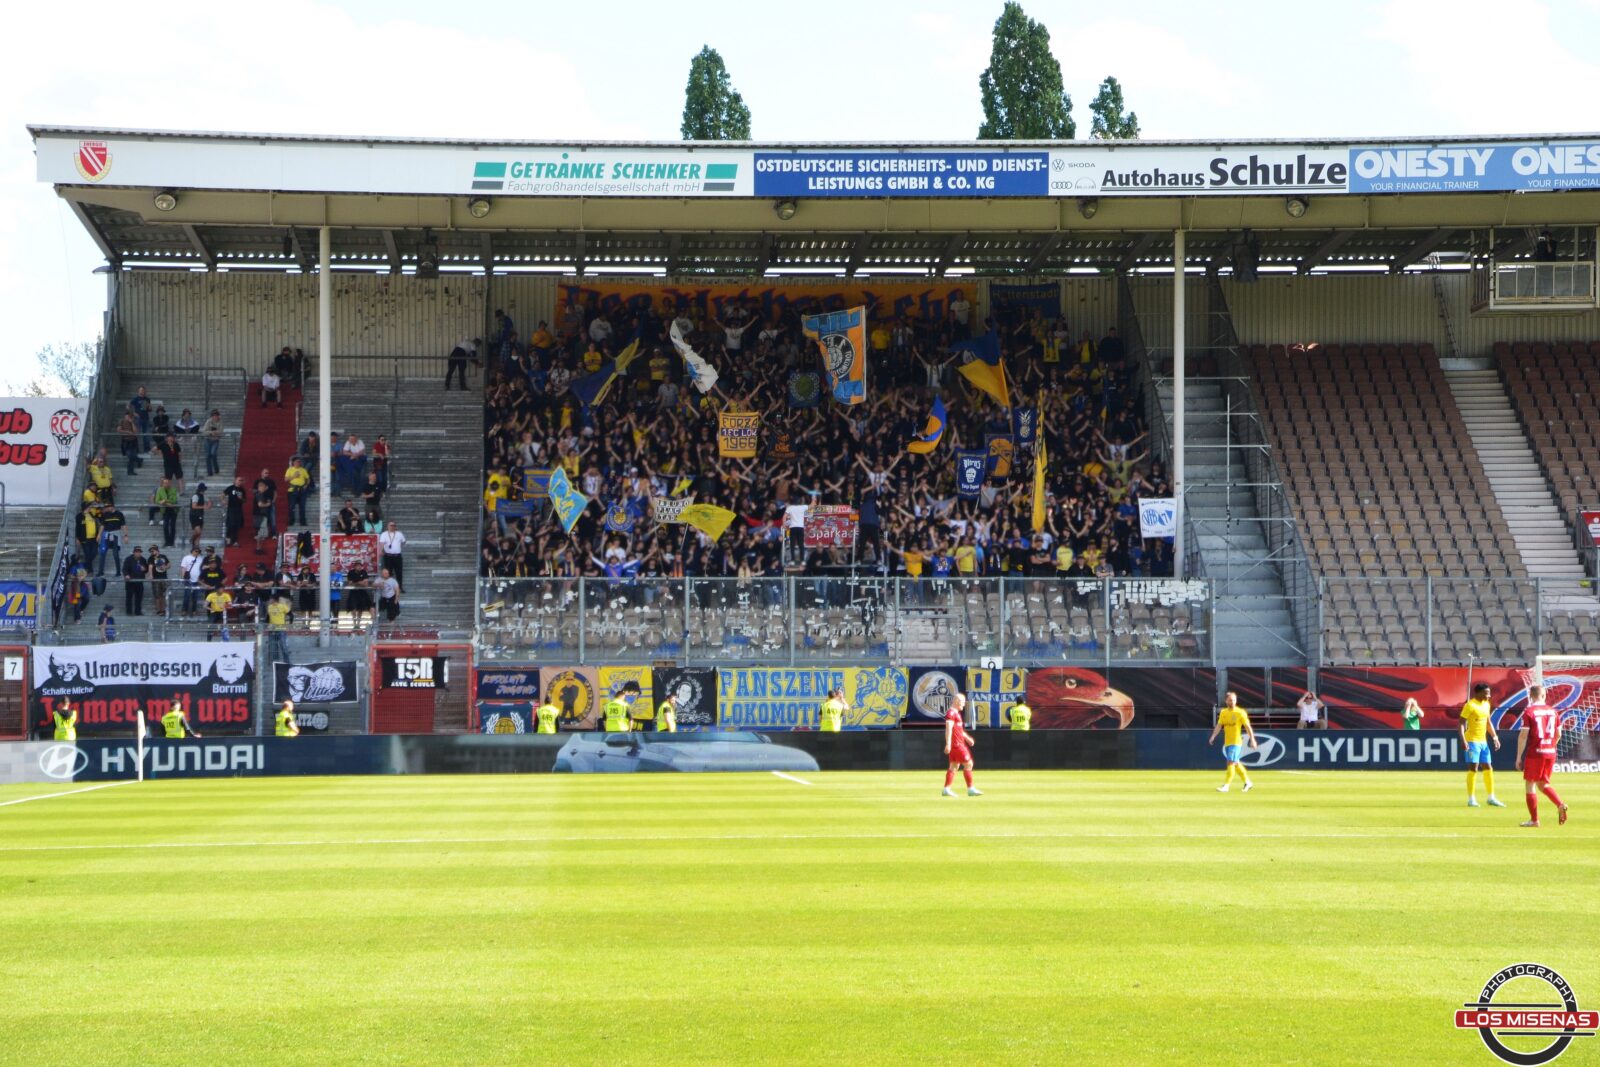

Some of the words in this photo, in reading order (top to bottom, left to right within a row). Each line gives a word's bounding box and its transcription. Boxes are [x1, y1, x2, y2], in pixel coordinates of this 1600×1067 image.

[510, 153, 606, 179] GETRÄNKE
[612, 162, 701, 179] SCHENKER
[756, 159, 854, 172] OSTDEUTSCHE
[858, 159, 952, 172] SICHERHEITS-
[957, 159, 988, 172] UND
[992, 158, 1047, 171] DIENST-
[1102, 168, 1205, 187] Autohaus
[1209, 154, 1347, 186] Schulze
[1354, 148, 1495, 179] ONESTY
[507, 181, 669, 193] Fachgroßhandelsgesellschaft
[673, 182, 700, 192] mbH
[808, 177, 883, 190] LEISTUNGS
[888, 177, 928, 189] GMBH
[933, 177, 943, 189] &
[948, 177, 971, 189] CO.
[976, 176, 995, 189] KG
[1370, 182, 1393, 191] YOUR
[1396, 181, 1441, 190] FINANCIAL
[1444, 180, 1479, 189] TRAINER
[1527, 179, 1551, 188] YOUR
[1554, 178, 1600, 187] FINANCIAL
[51, 415, 80, 435] RCC
[722, 416, 758, 428] FORZA
[723, 437, 756, 449] 1966
[10, 662, 17, 675] 7
[42, 687, 71, 696] Schalke
[720, 670, 844, 697] FANSZENE
[40, 696, 139, 726] Imer
[197, 697, 249, 723] uns
[720, 702, 846, 726] LOKOMOTI
[1535, 715, 1556, 738] 14
[101, 744, 265, 773] HYUNDAI
[1298, 737, 1458, 763] HYUNDAI
